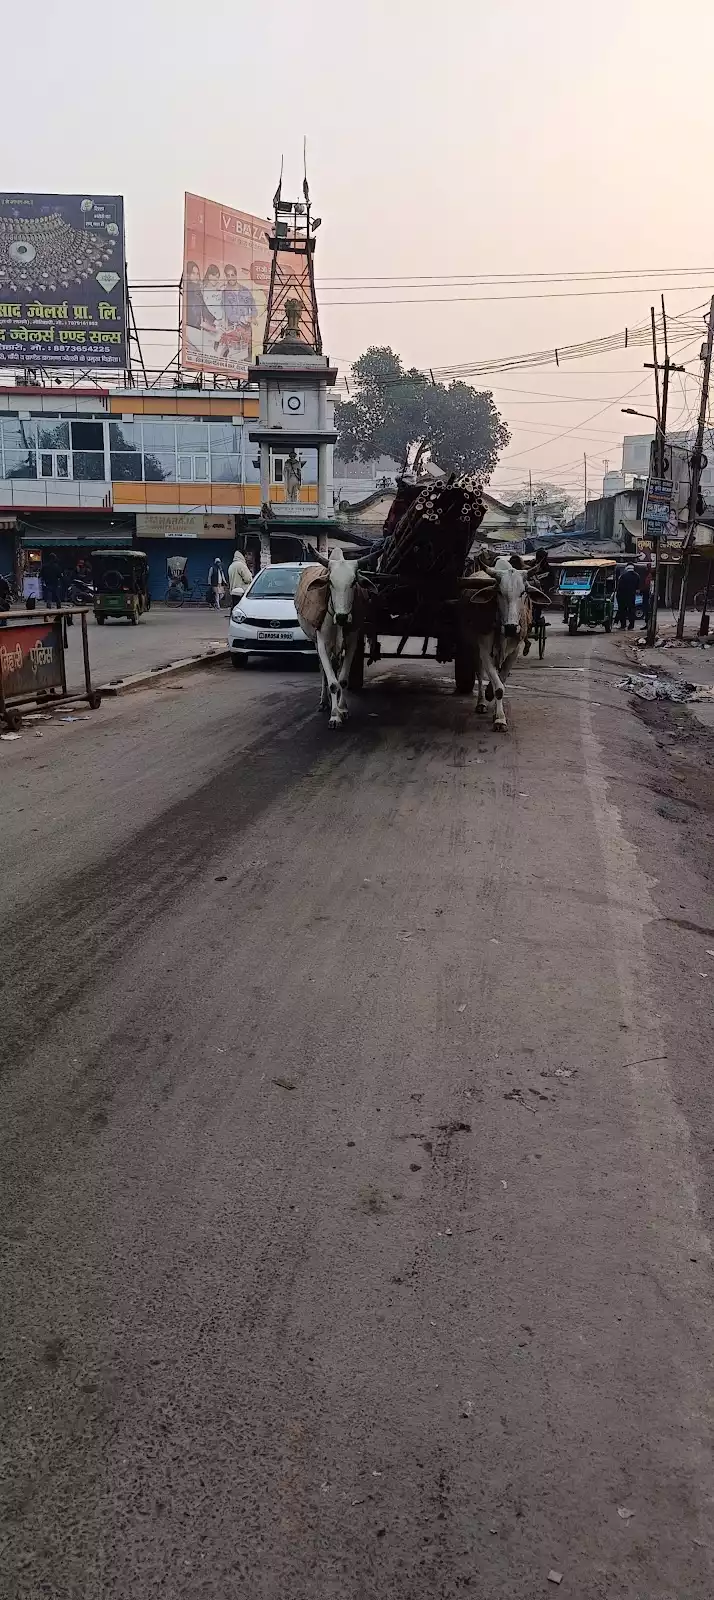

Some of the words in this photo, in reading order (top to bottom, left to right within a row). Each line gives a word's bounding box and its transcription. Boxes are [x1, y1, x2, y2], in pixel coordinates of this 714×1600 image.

[222, 214, 271, 243] V-BAZA
[98, 302, 121, 320] लि.
[10, 326, 55, 343] ज्वेलर्स
[59, 330, 86, 344] एण्ड
[89, 331, 122, 344] सन्स
[29, 639, 54, 675] पुलिस
